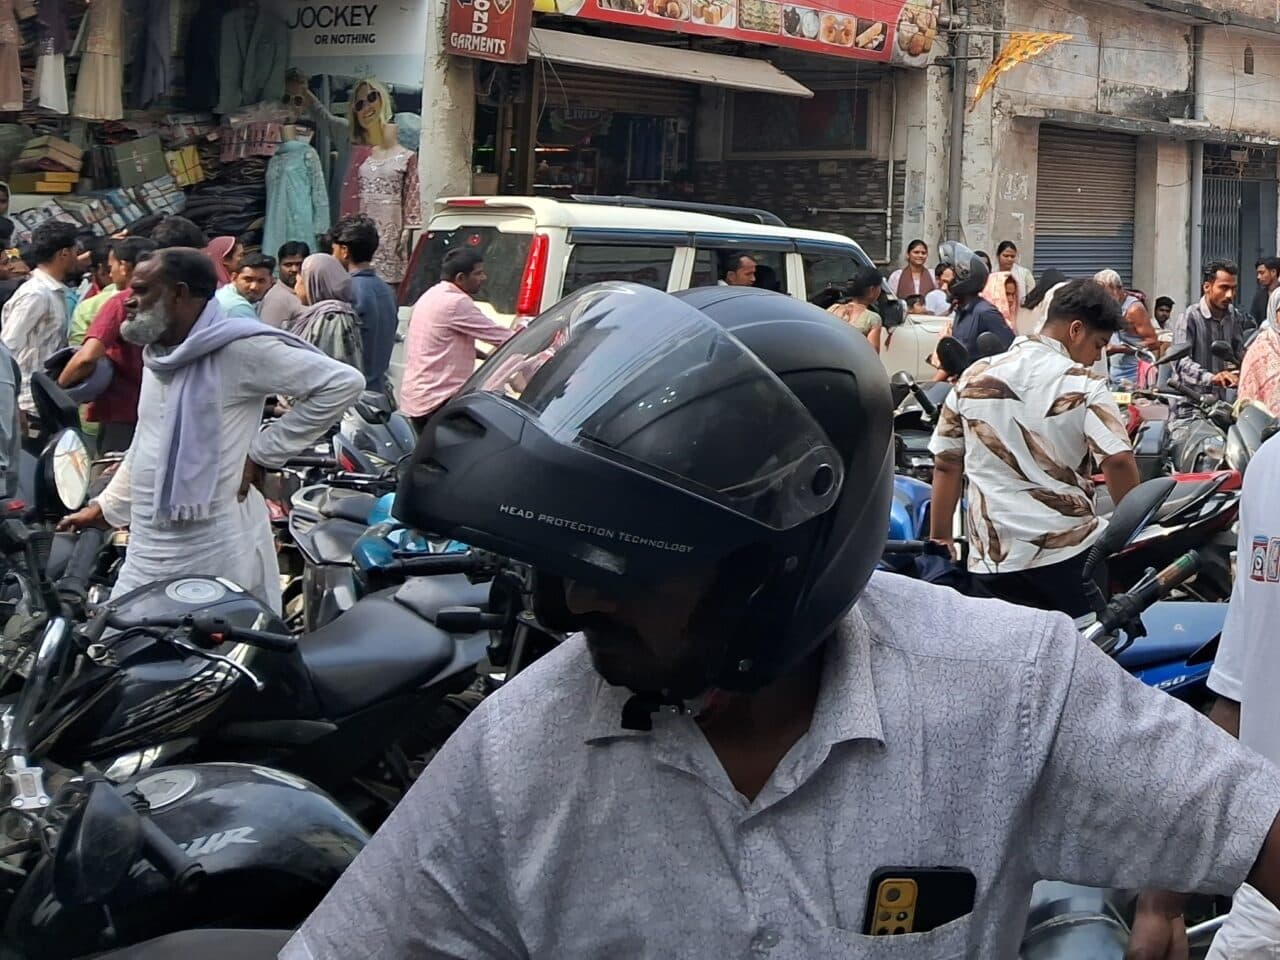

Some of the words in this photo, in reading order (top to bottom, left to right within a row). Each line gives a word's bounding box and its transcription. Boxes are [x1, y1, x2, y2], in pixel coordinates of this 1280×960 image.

[287, 4, 378, 30] JOCKEY
[314, 34, 329, 46] OR
[329, 33, 377, 45] NOTHING
[450, 32, 506, 55] GARMENTS
[499, 503, 535, 520] HEAD
[537, 513, 615, 538] PROTECTION
[619, 531, 695, 554] TECHNOLOGY
